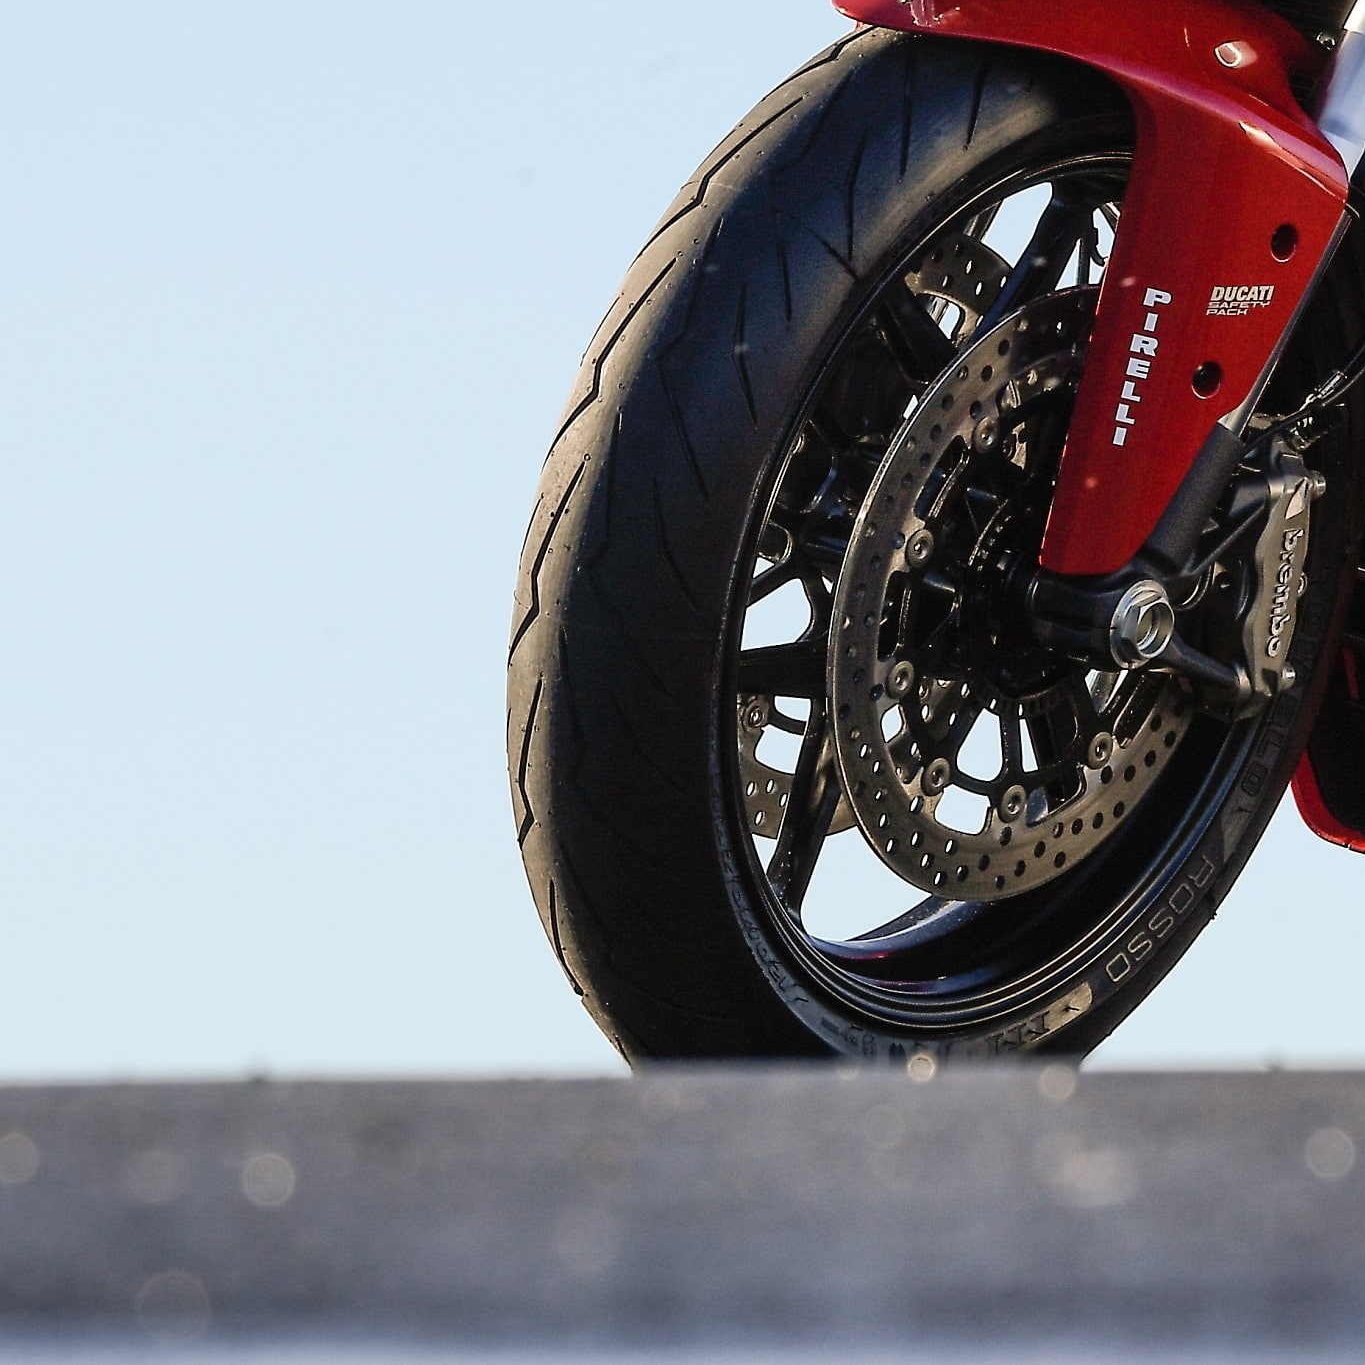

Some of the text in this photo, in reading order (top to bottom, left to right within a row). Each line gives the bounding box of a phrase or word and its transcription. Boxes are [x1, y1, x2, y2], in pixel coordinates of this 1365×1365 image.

[1205, 308, 1249, 316] PACK
[1207, 301, 1271, 309] SAFETY
[1210, 285, 1275, 301] DUCATI
[1112, 287, 1172, 447] PIRELLI
[1265, 528, 1305, 658] brembo
[1105, 853, 1216, 983] ROSSO
